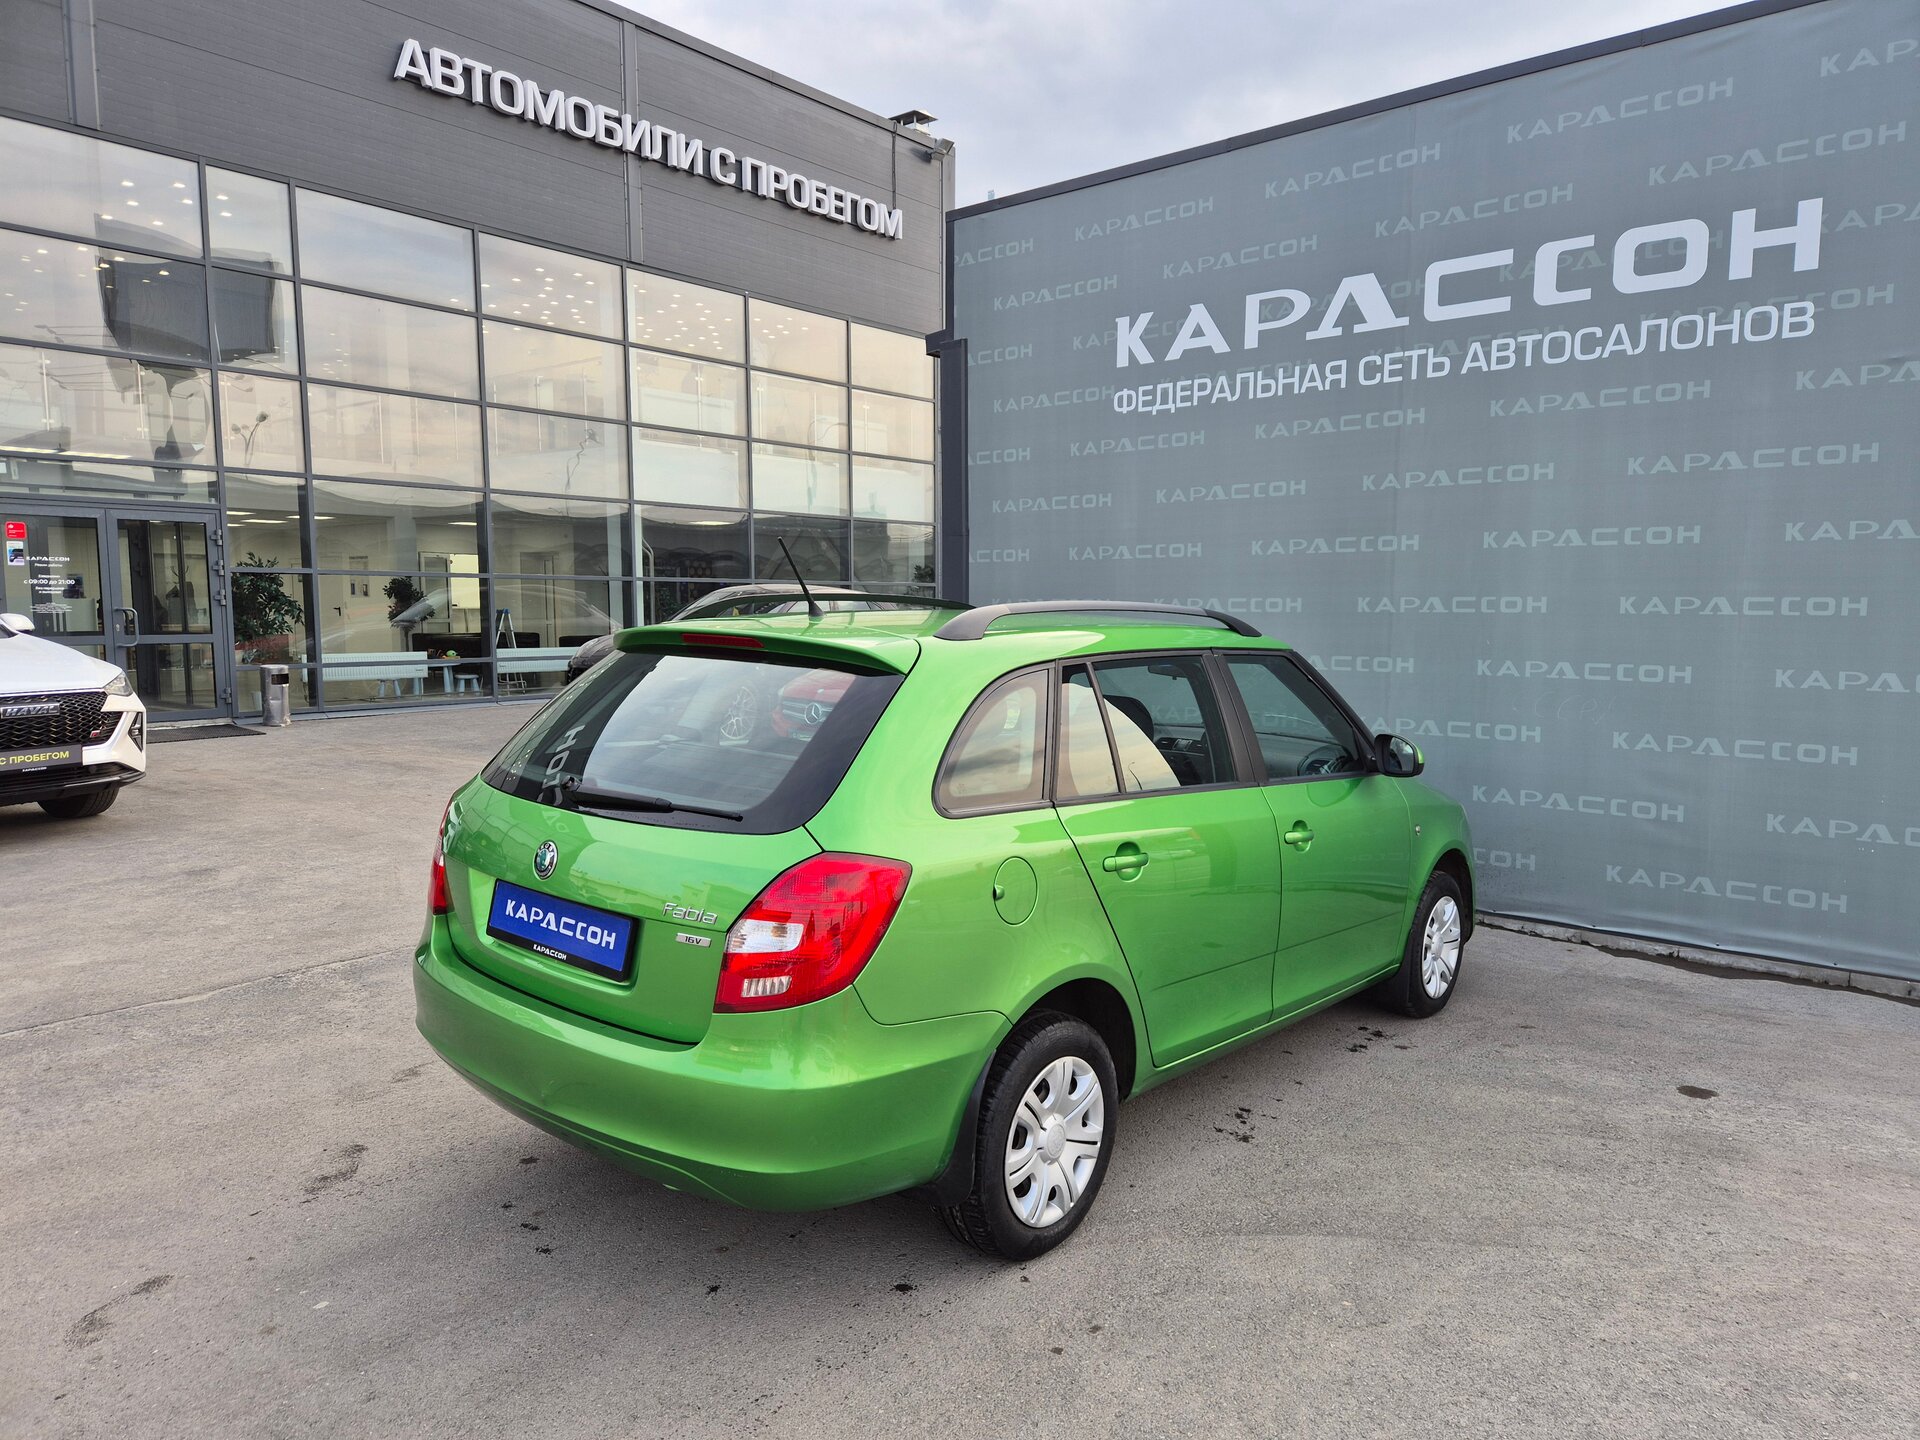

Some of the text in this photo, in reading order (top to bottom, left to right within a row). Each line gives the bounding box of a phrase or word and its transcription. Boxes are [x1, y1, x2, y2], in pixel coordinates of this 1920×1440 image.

[1820, 39, 1920, 77] КАР
[1508, 77, 1733, 143] КАРАССОН
[394, 38, 903, 239] АВТОМОБИЛИ С ПРОБЕГОМ
[1649, 121, 1906, 186] КАРАССОН
[1266, 143, 1440, 198] КАРАССОН
[1075, 197, 1213, 241] КАРАССОН
[1375, 183, 1574, 238] КАРАССОН
[1164, 235, 1317, 279] КАРАССОН
[994, 275, 1117, 310] КАРАССОН
[1115, 197, 1823, 368] КАРАССОН
[1113, 301, 1815, 415] ФЕДЕРАЛЬНАЯ СЕТЬ АВТОСАЛОНОВ
[1491, 380, 1710, 416] КАРАССОН
[1256, 408, 1425, 439] КАРАССОН
[1071, 430, 1204, 456] КАРАССОН
[1628, 443, 1879, 475] КАРАССОН
[1157, 480, 1305, 503] КАРАССОН
[1363, 463, 1554, 491] КАРАССОН
[993, 493, 1111, 513] КАРАССОН
[1069, 543, 1201, 560] КАРАССОН
[1252, 535, 1419, 555] КАРАССОН
[1483, 526, 1700, 548] КАРАССОН
[1358, 597, 1547, 613] КАРАССОН
[1620, 597, 1867, 616] КАРАССОН
[1477, 660, 1691, 683] КАРАССОН
[6, 705, 58, 716] HAVAL
[1362, 716, 1541, 743] АРАССОН
[9, 751, 69, 763] ПРОБЕГОМ
[1613, 732, 1857, 765] КАРАССОН
[1473, 786, 1684, 822] КАРАССОН
[1606, 865, 1848, 913] КАРАССОН
[505, 898, 616, 950] КАРАССОН
[662, 902, 718, 925] Fabia
[533, 943, 567, 961] КАРАССОН
[684, 936, 702, 945] 16V
